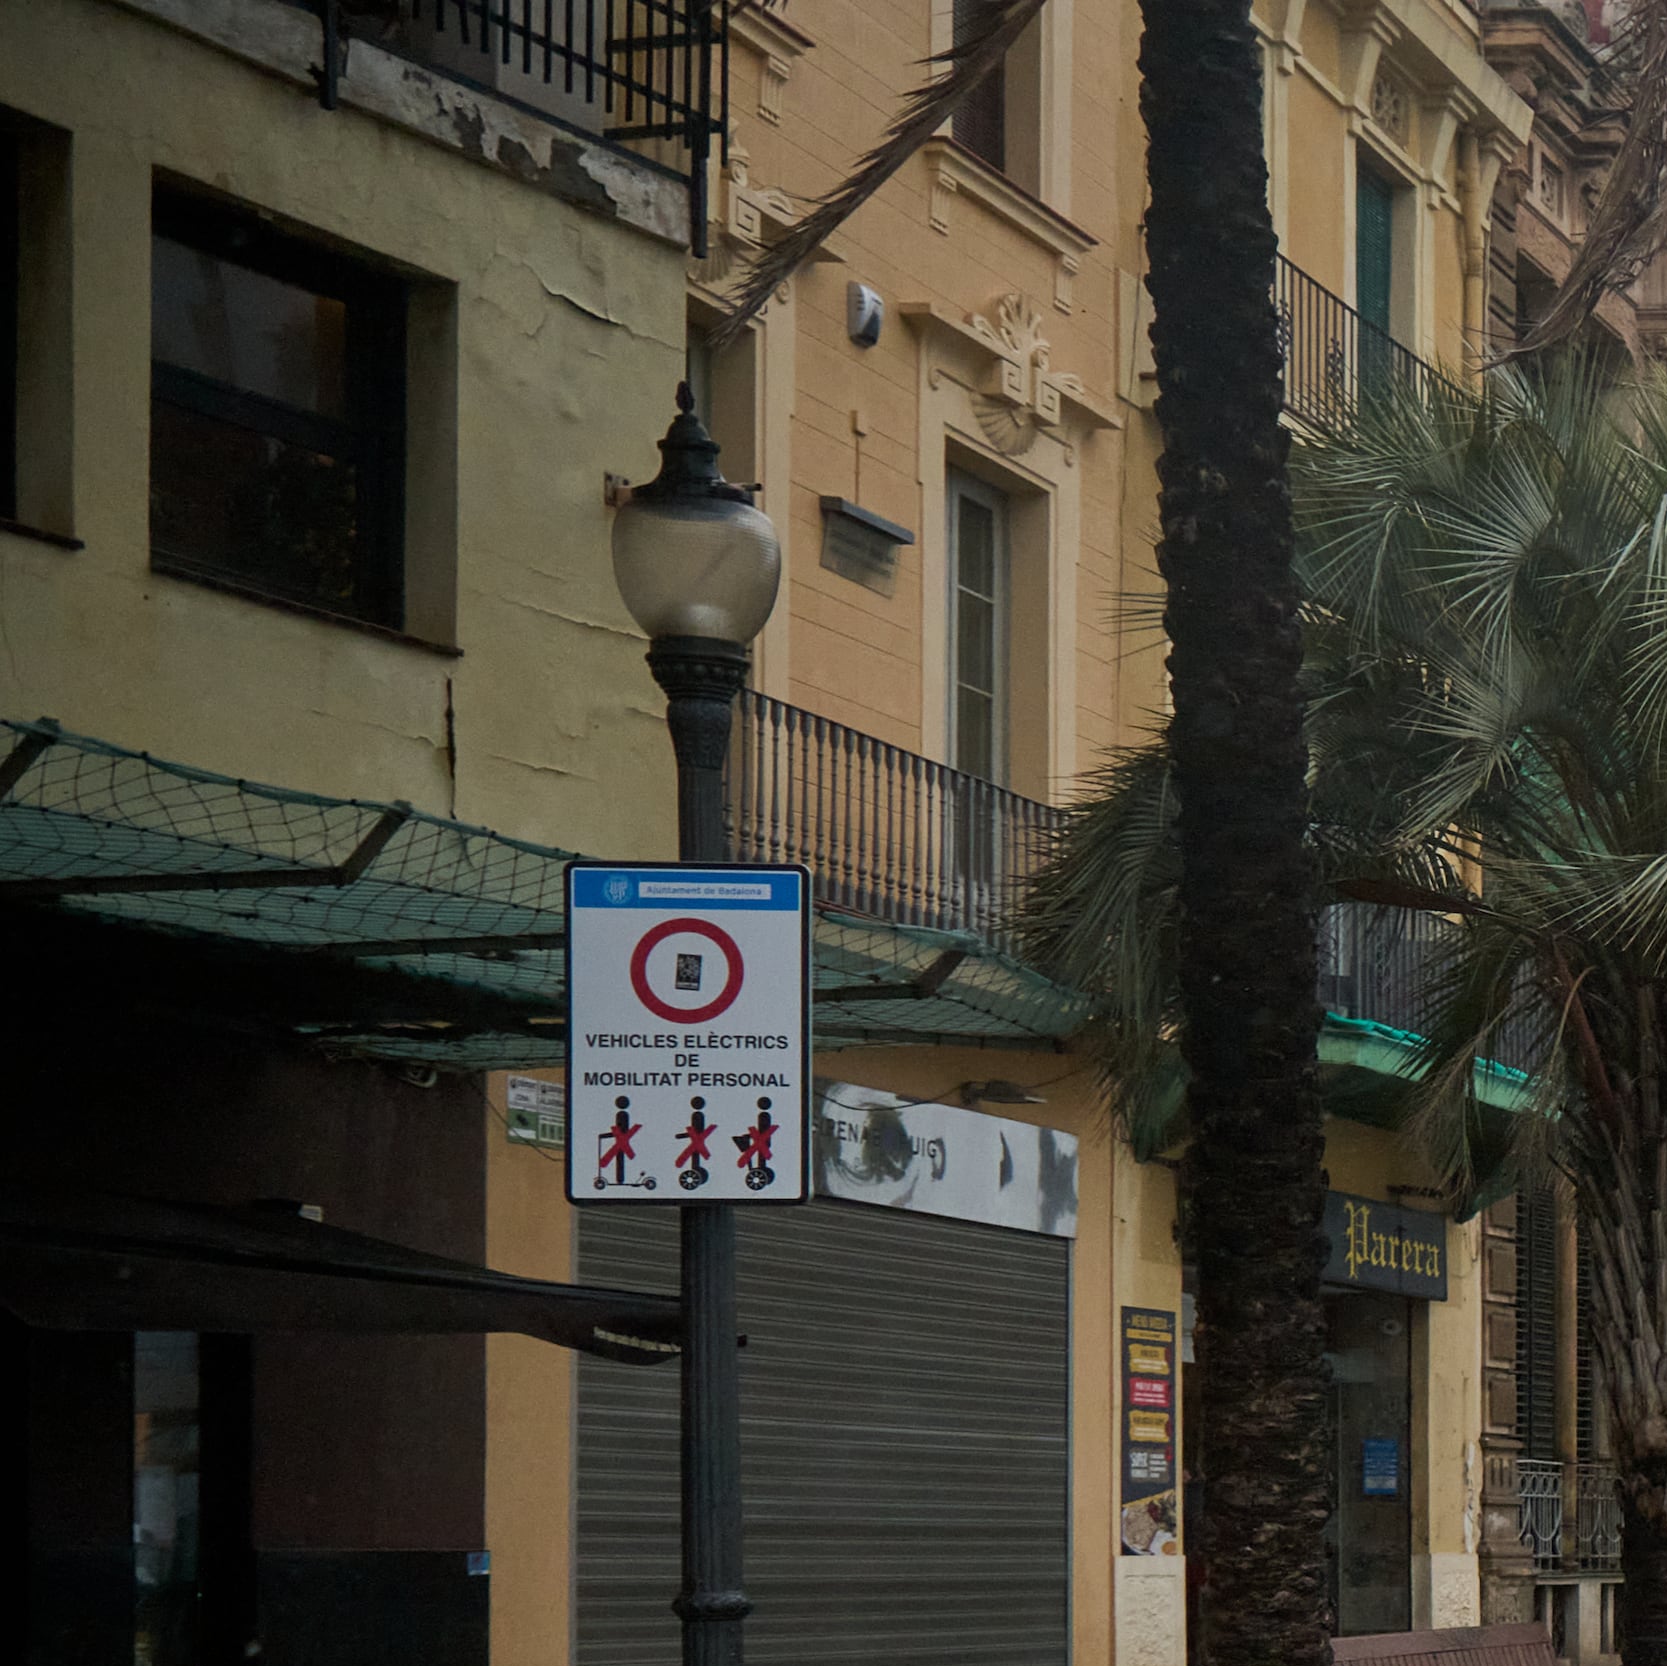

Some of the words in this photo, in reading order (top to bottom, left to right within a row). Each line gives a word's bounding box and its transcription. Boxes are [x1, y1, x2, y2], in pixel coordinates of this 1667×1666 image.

[646, 885, 701, 897] Ajuntament
[704, 886, 715, 896] de
[718, 886, 762, 897] Badalona
[585, 1034, 678, 1048] VEHICLES
[684, 1031, 789, 1049] ELÈCTRICS
[674, 1054, 700, 1067] DE
[584, 1072, 682, 1087] MOBILITAT
[688, 1073, 790, 1087] PERSONAL
[1344, 1201, 1440, 1278] Parera
